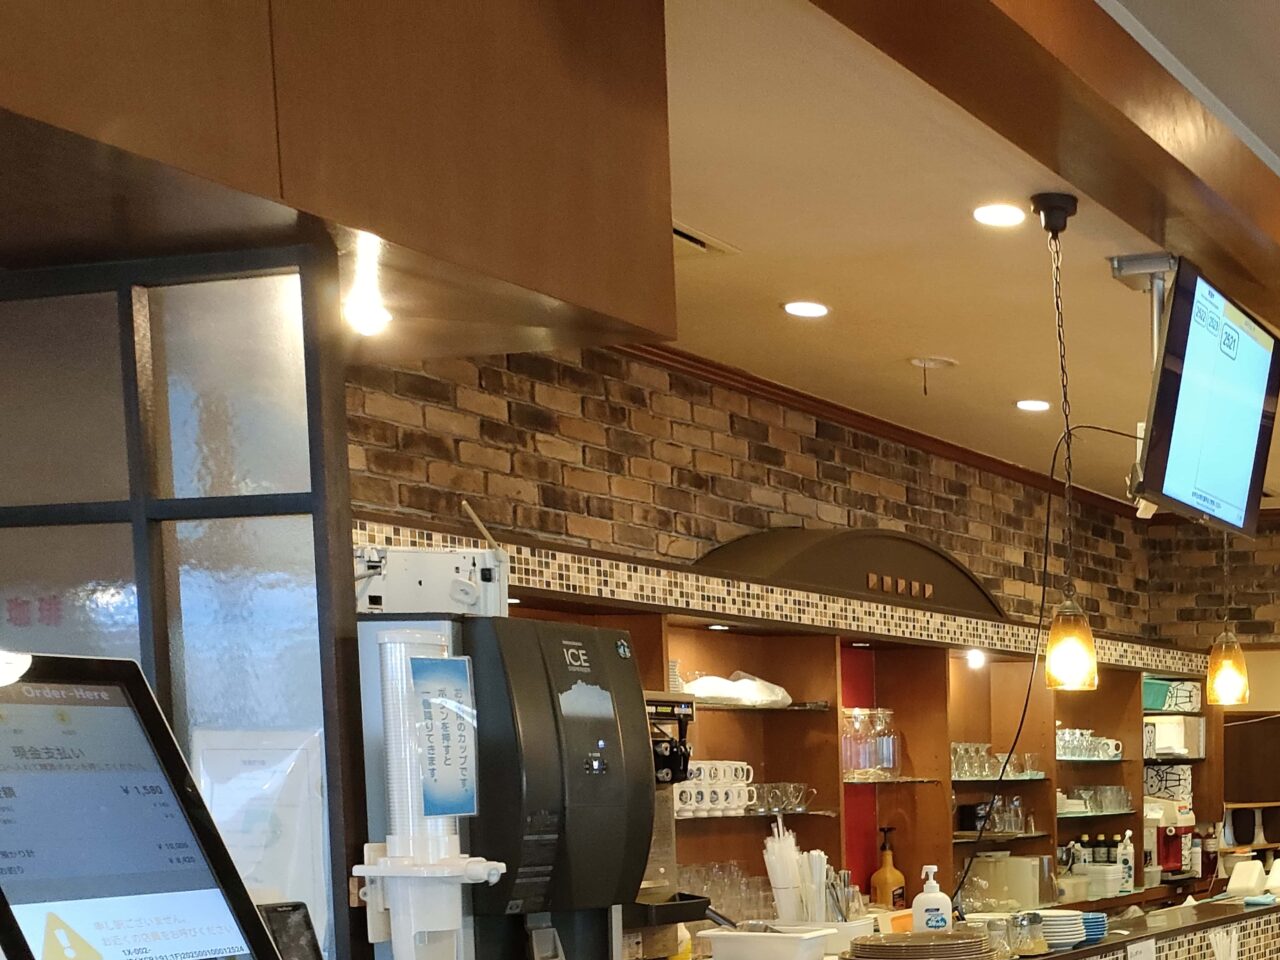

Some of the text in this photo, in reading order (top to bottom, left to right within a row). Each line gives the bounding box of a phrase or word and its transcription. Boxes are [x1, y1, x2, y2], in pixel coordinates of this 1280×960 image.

[1223, 331, 1236, 351] 2521
[563, 648, 590, 667] ICE
[22, 686, 110, 700] Order-Here
